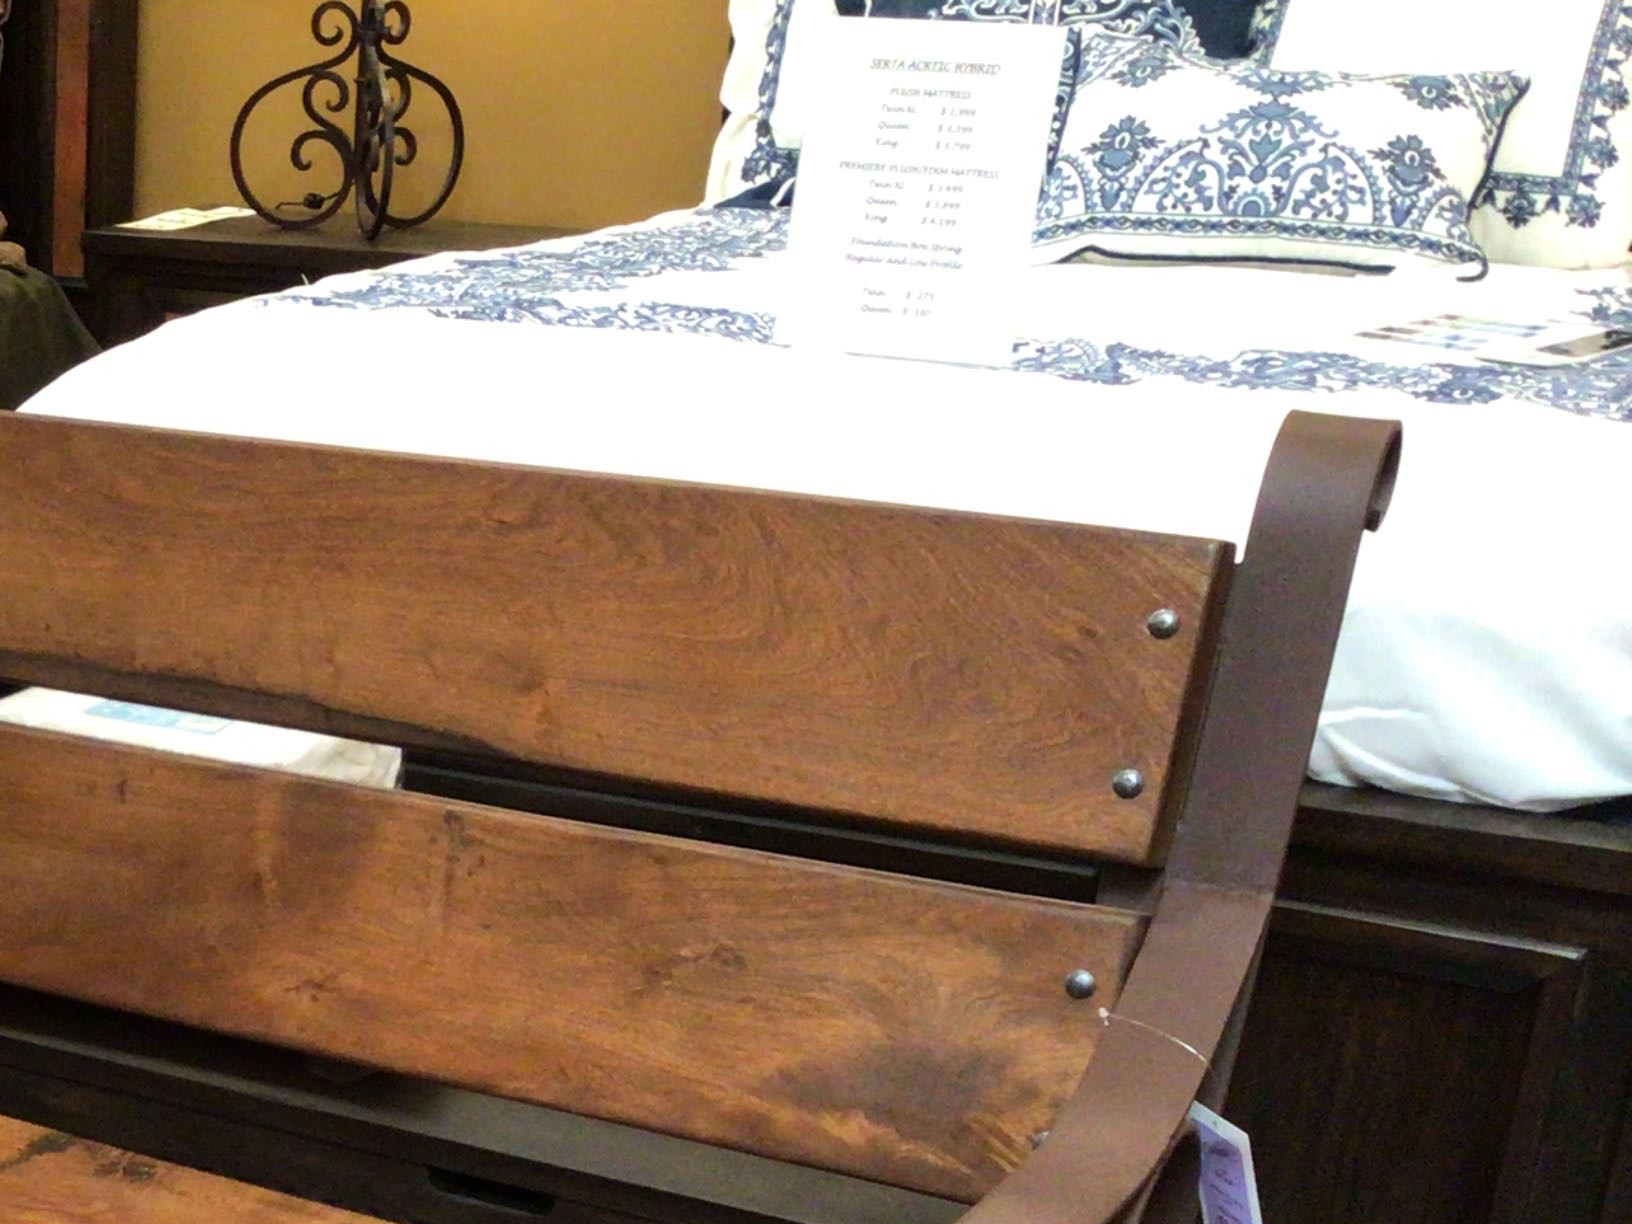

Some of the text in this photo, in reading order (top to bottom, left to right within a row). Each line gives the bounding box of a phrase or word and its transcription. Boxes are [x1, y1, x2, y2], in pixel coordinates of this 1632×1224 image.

[869, 57, 905, 71] SERTA
[954, 61, 1001, 76] HYBRID
[889, 87, 972, 100] PLUSH MATTRESS
[877, 121, 910, 131] Queen
[950, 168, 1000, 180] MATTRESS
[865, 196, 898, 206] Queen
[886, 256, 908, 265] and
